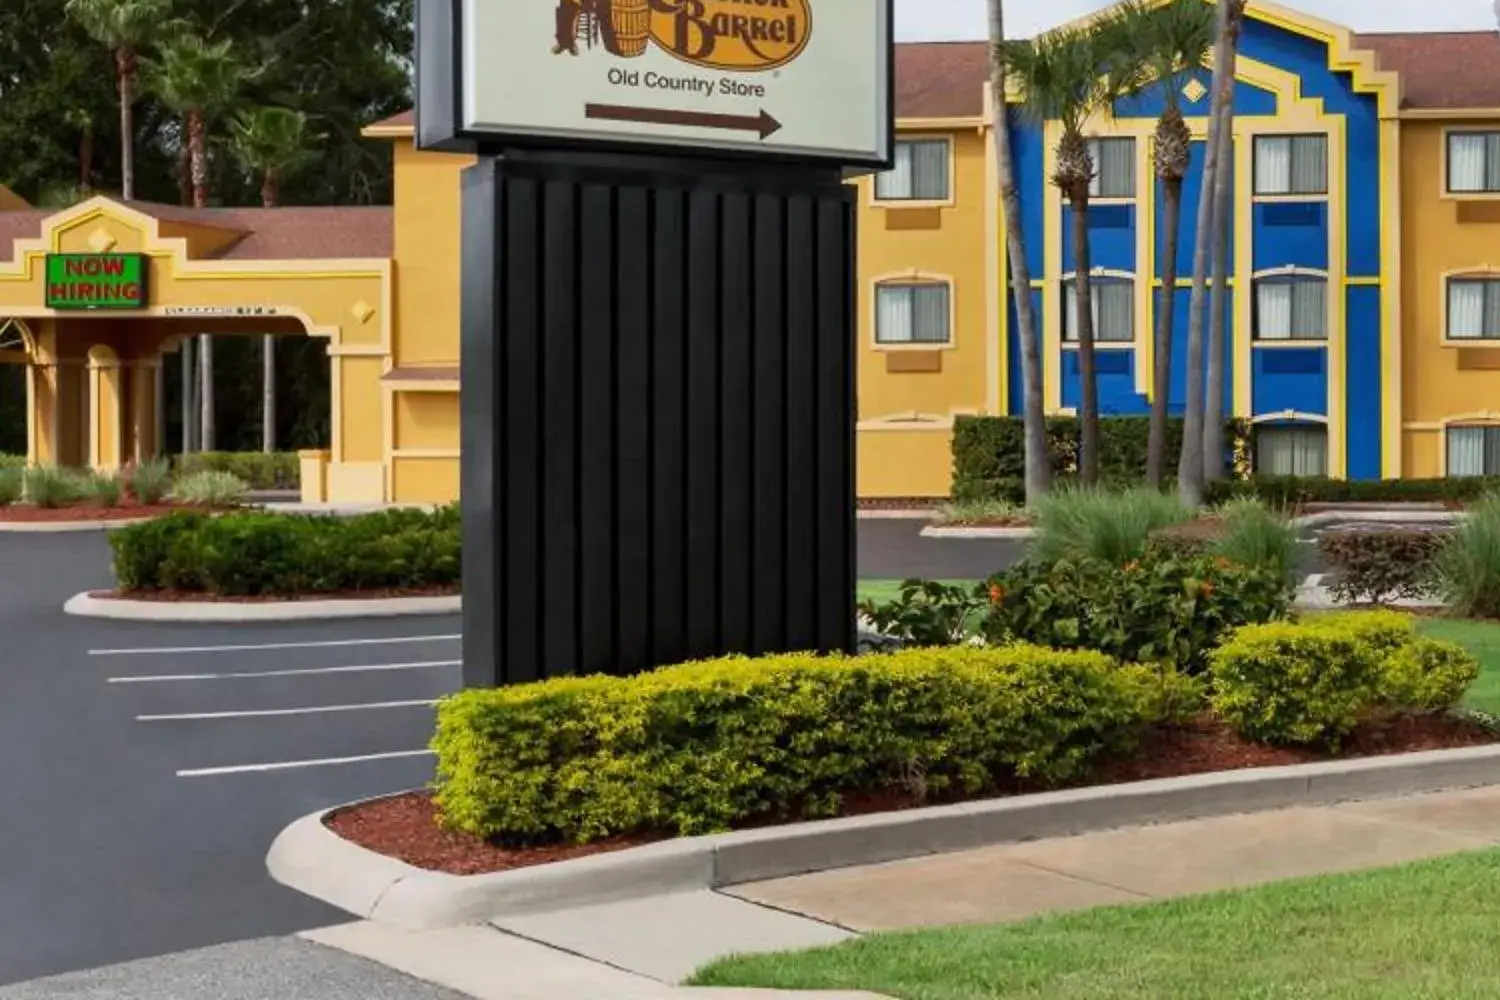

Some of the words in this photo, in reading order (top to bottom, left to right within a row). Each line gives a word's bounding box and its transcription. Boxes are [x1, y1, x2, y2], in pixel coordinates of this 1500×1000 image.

[607, 68, 639, 87] Old
[644, 71, 715, 97] Country
[719, 77, 765, 97] Store
[65, 257, 125, 277] NOW
[49, 282, 141, 300] HIRING
